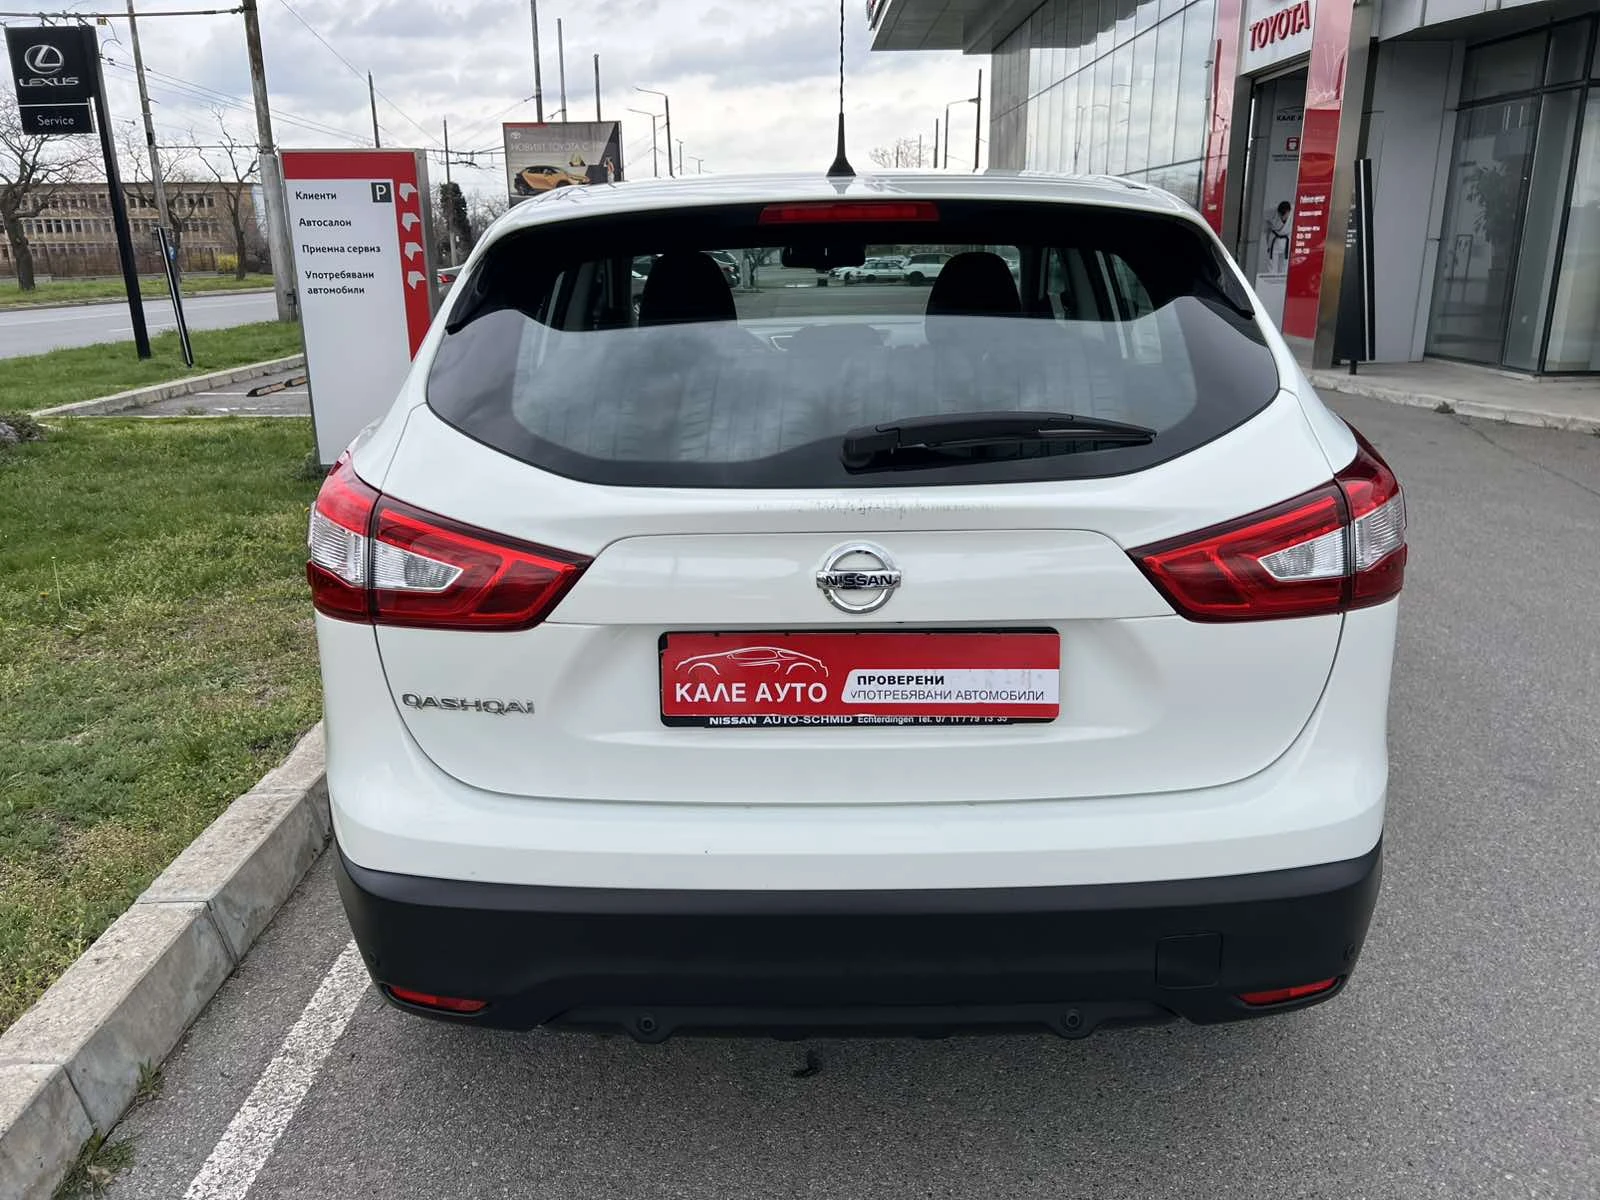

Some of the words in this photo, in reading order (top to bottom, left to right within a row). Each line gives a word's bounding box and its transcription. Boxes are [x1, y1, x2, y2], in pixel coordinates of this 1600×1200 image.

[1249, 0, 1310, 51] TOYOTA
[18, 76, 79, 87] LEXUS
[37, 114, 75, 126] Service
[295, 191, 337, 200] Клиенти
[299, 217, 352, 227] Автосалон
[302, 244, 345, 255] Приемна
[347, 245, 381, 255] сервиз
[305, 270, 375, 280] Употребявани
[307, 286, 365, 294] автомобили
[825, 573, 894, 587] NISSAN
[857, 675, 945, 685] ПРОВЕРЕНИ
[675, 682, 747, 703] КАЛЕ
[755, 682, 827, 703] АУТО
[850, 689, 952, 701] УПОТРЕБЯВАНИ
[955, 689, 1045, 701] АВТОМОБИЛИ
[401, 693, 536, 716] QASHQAI
[709, 716, 757, 725] NISSAN
[762, 715, 853, 725] AUTO-SCHMID
[858, 715, 914, 725] Echterdingen
